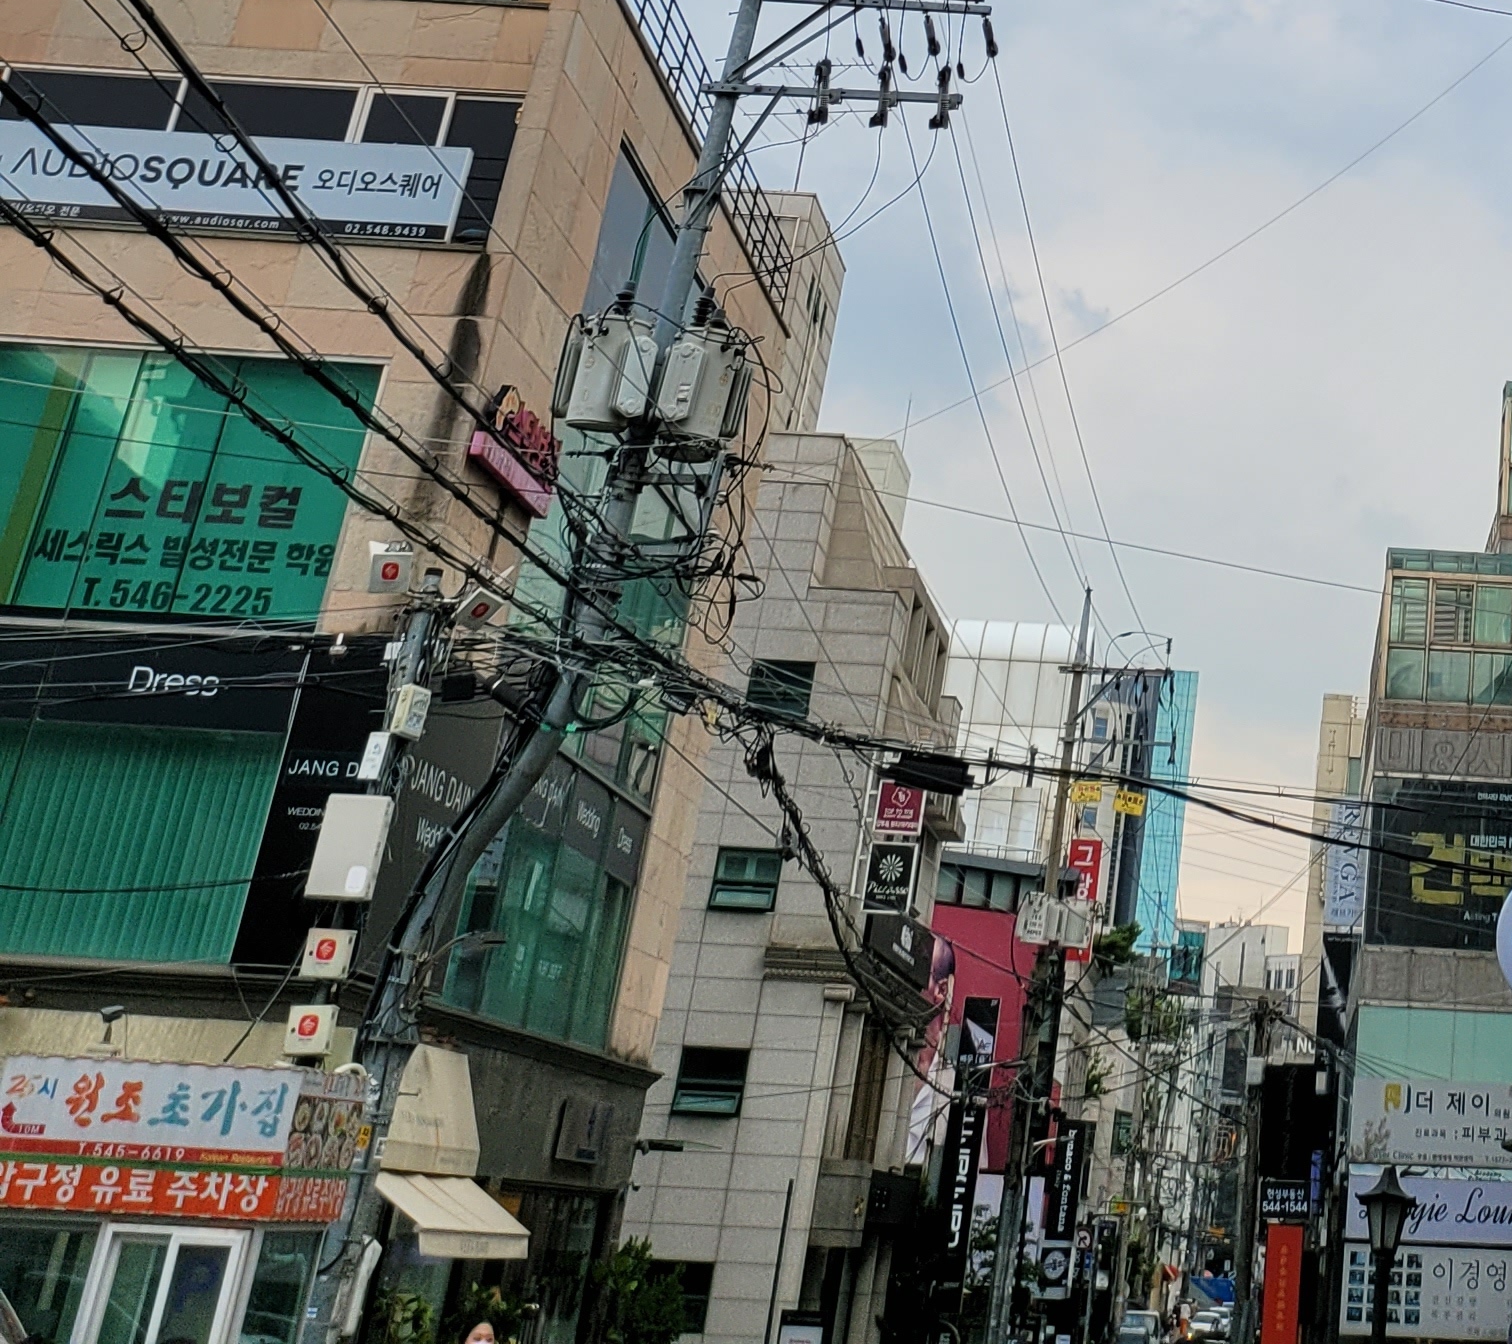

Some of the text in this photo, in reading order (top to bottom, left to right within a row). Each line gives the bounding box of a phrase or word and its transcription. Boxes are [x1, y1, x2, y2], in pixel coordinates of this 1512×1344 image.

[311, 167, 443, 201] 오디오스퀘어
[343, 222, 427, 238] 02.548.9439
[108, 578, 274, 616] 546-2225
[287, 759, 340, 777] JANG
[409, 762, 445, 801] JANG
[1470, 834, 1507, 849] 대한민국
[65, 1071, 146, 1127] 원조
[90, 1169, 163, 1206] 유료
[165, 1171, 270, 1214] 주차장
[1262, 1200, 1308, 1213] 544-1544
[1431, 1258, 1508, 1292] 이경영
